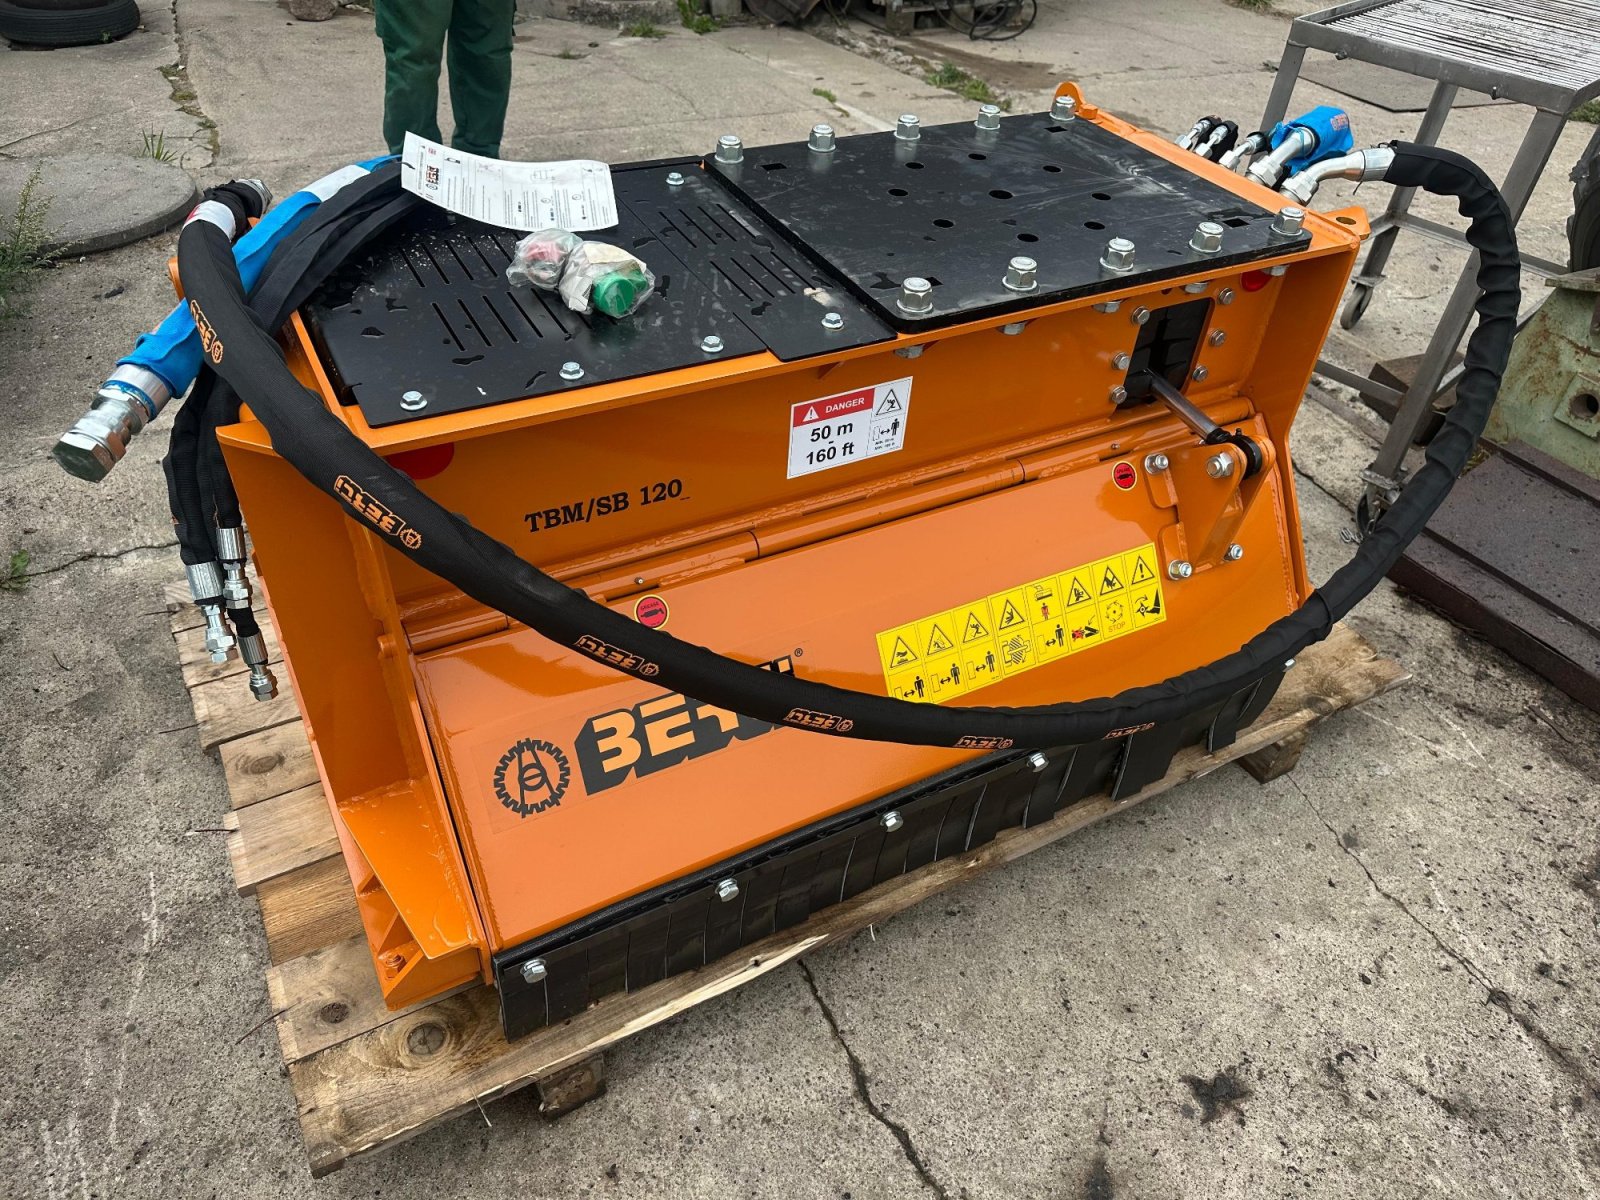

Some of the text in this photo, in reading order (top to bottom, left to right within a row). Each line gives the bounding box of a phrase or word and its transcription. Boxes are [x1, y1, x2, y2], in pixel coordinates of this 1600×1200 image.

[825, 397, 865, 413] DANGER
[810, 422, 853, 442] 50 m
[806, 442, 854, 465] 160 ft
[524, 492, 629, 532] TBM/SB
[1108, 621, 1126, 633] STOP
